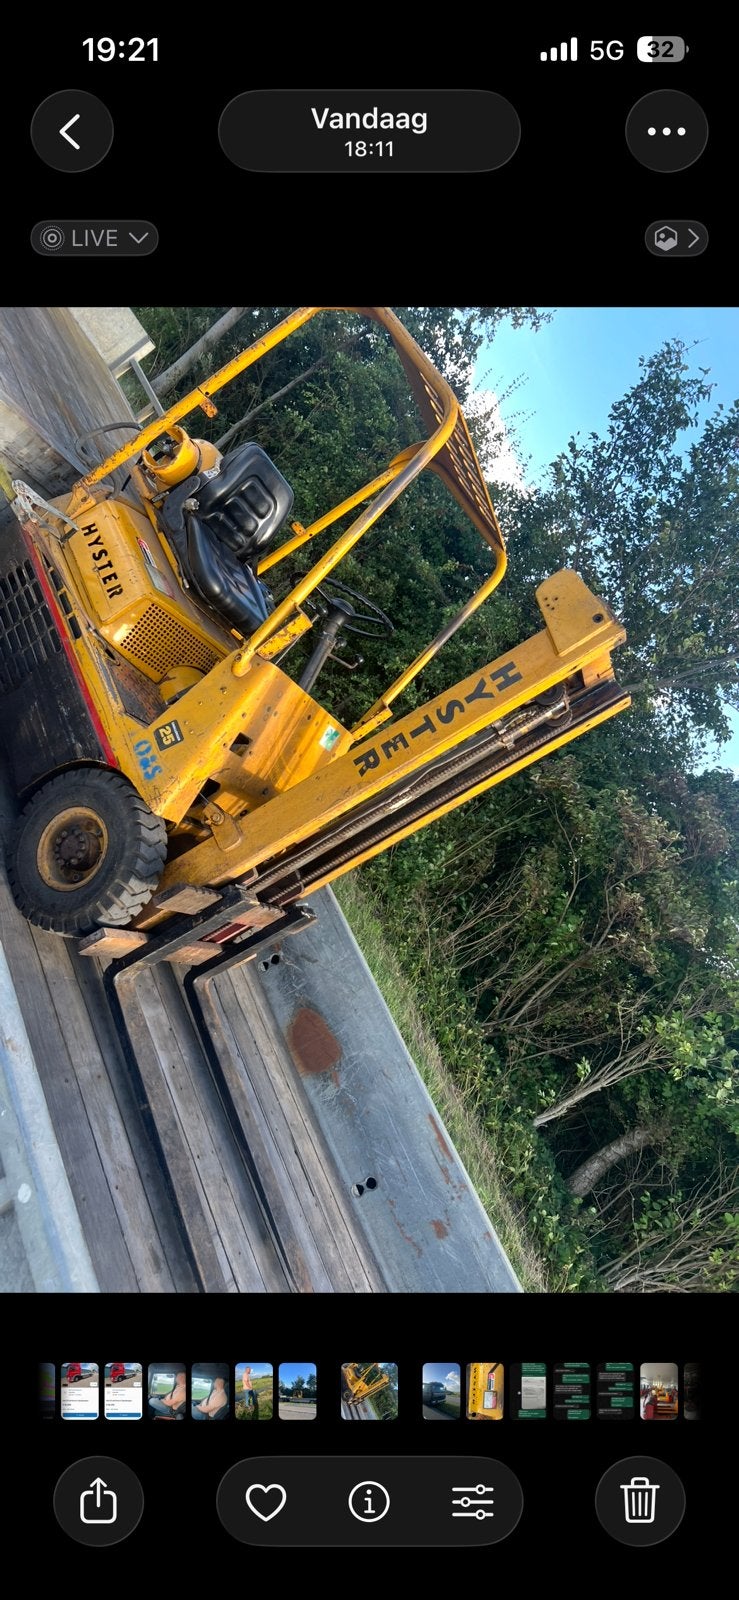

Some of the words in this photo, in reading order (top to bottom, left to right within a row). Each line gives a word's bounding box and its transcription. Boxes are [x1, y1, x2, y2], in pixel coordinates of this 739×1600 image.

[81, 523, 123, 599] HYSTER
[159, 725, 175, 745] 25
[353, 661, 523, 777] HYSTER
